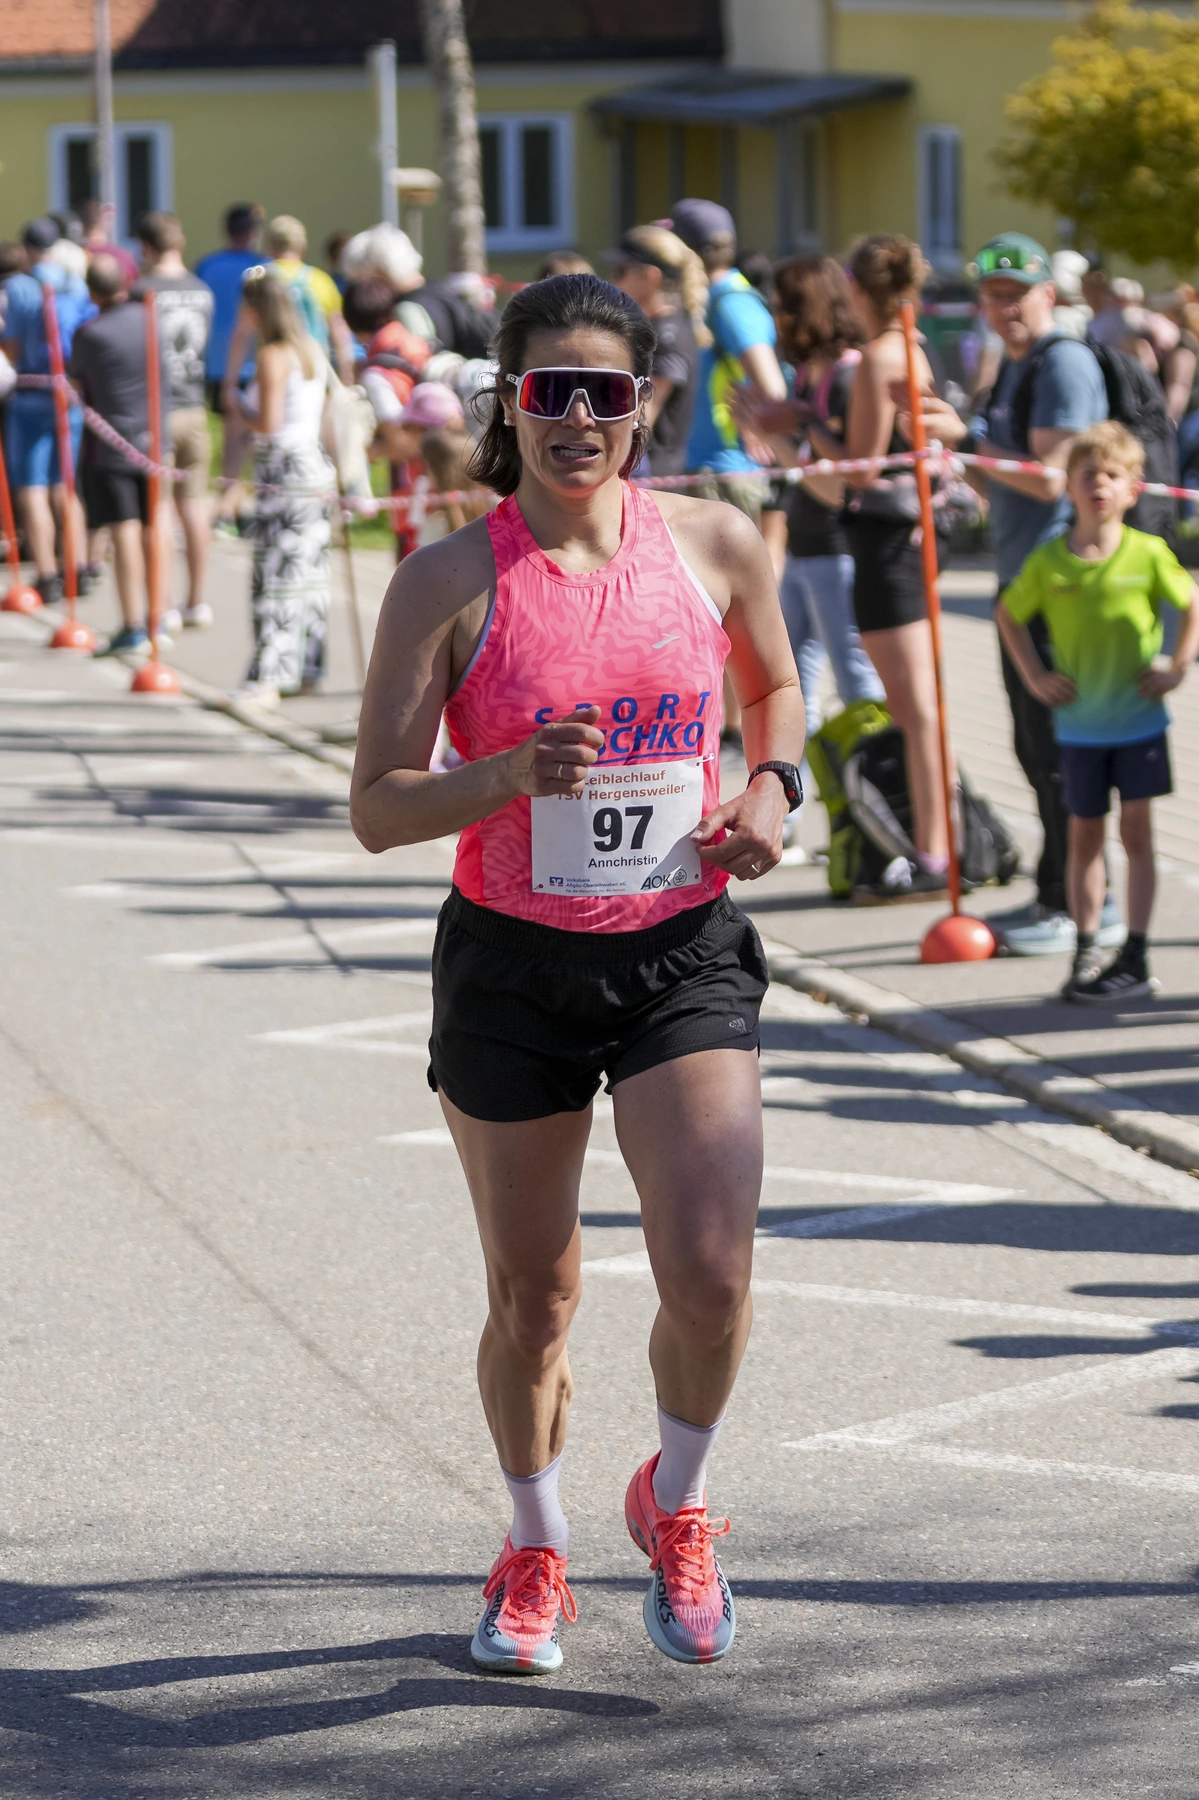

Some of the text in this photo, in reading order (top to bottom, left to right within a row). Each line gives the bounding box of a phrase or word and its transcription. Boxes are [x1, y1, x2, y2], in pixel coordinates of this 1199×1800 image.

[535, 692, 711, 725] SORT
[588, 784, 686, 801] Hergensweiler
[593, 805, 653, 852] 97
[588, 855, 658, 868] Annchristin
[640, 874, 671, 890] AOK
[658, 1558, 677, 1624] OOKS
